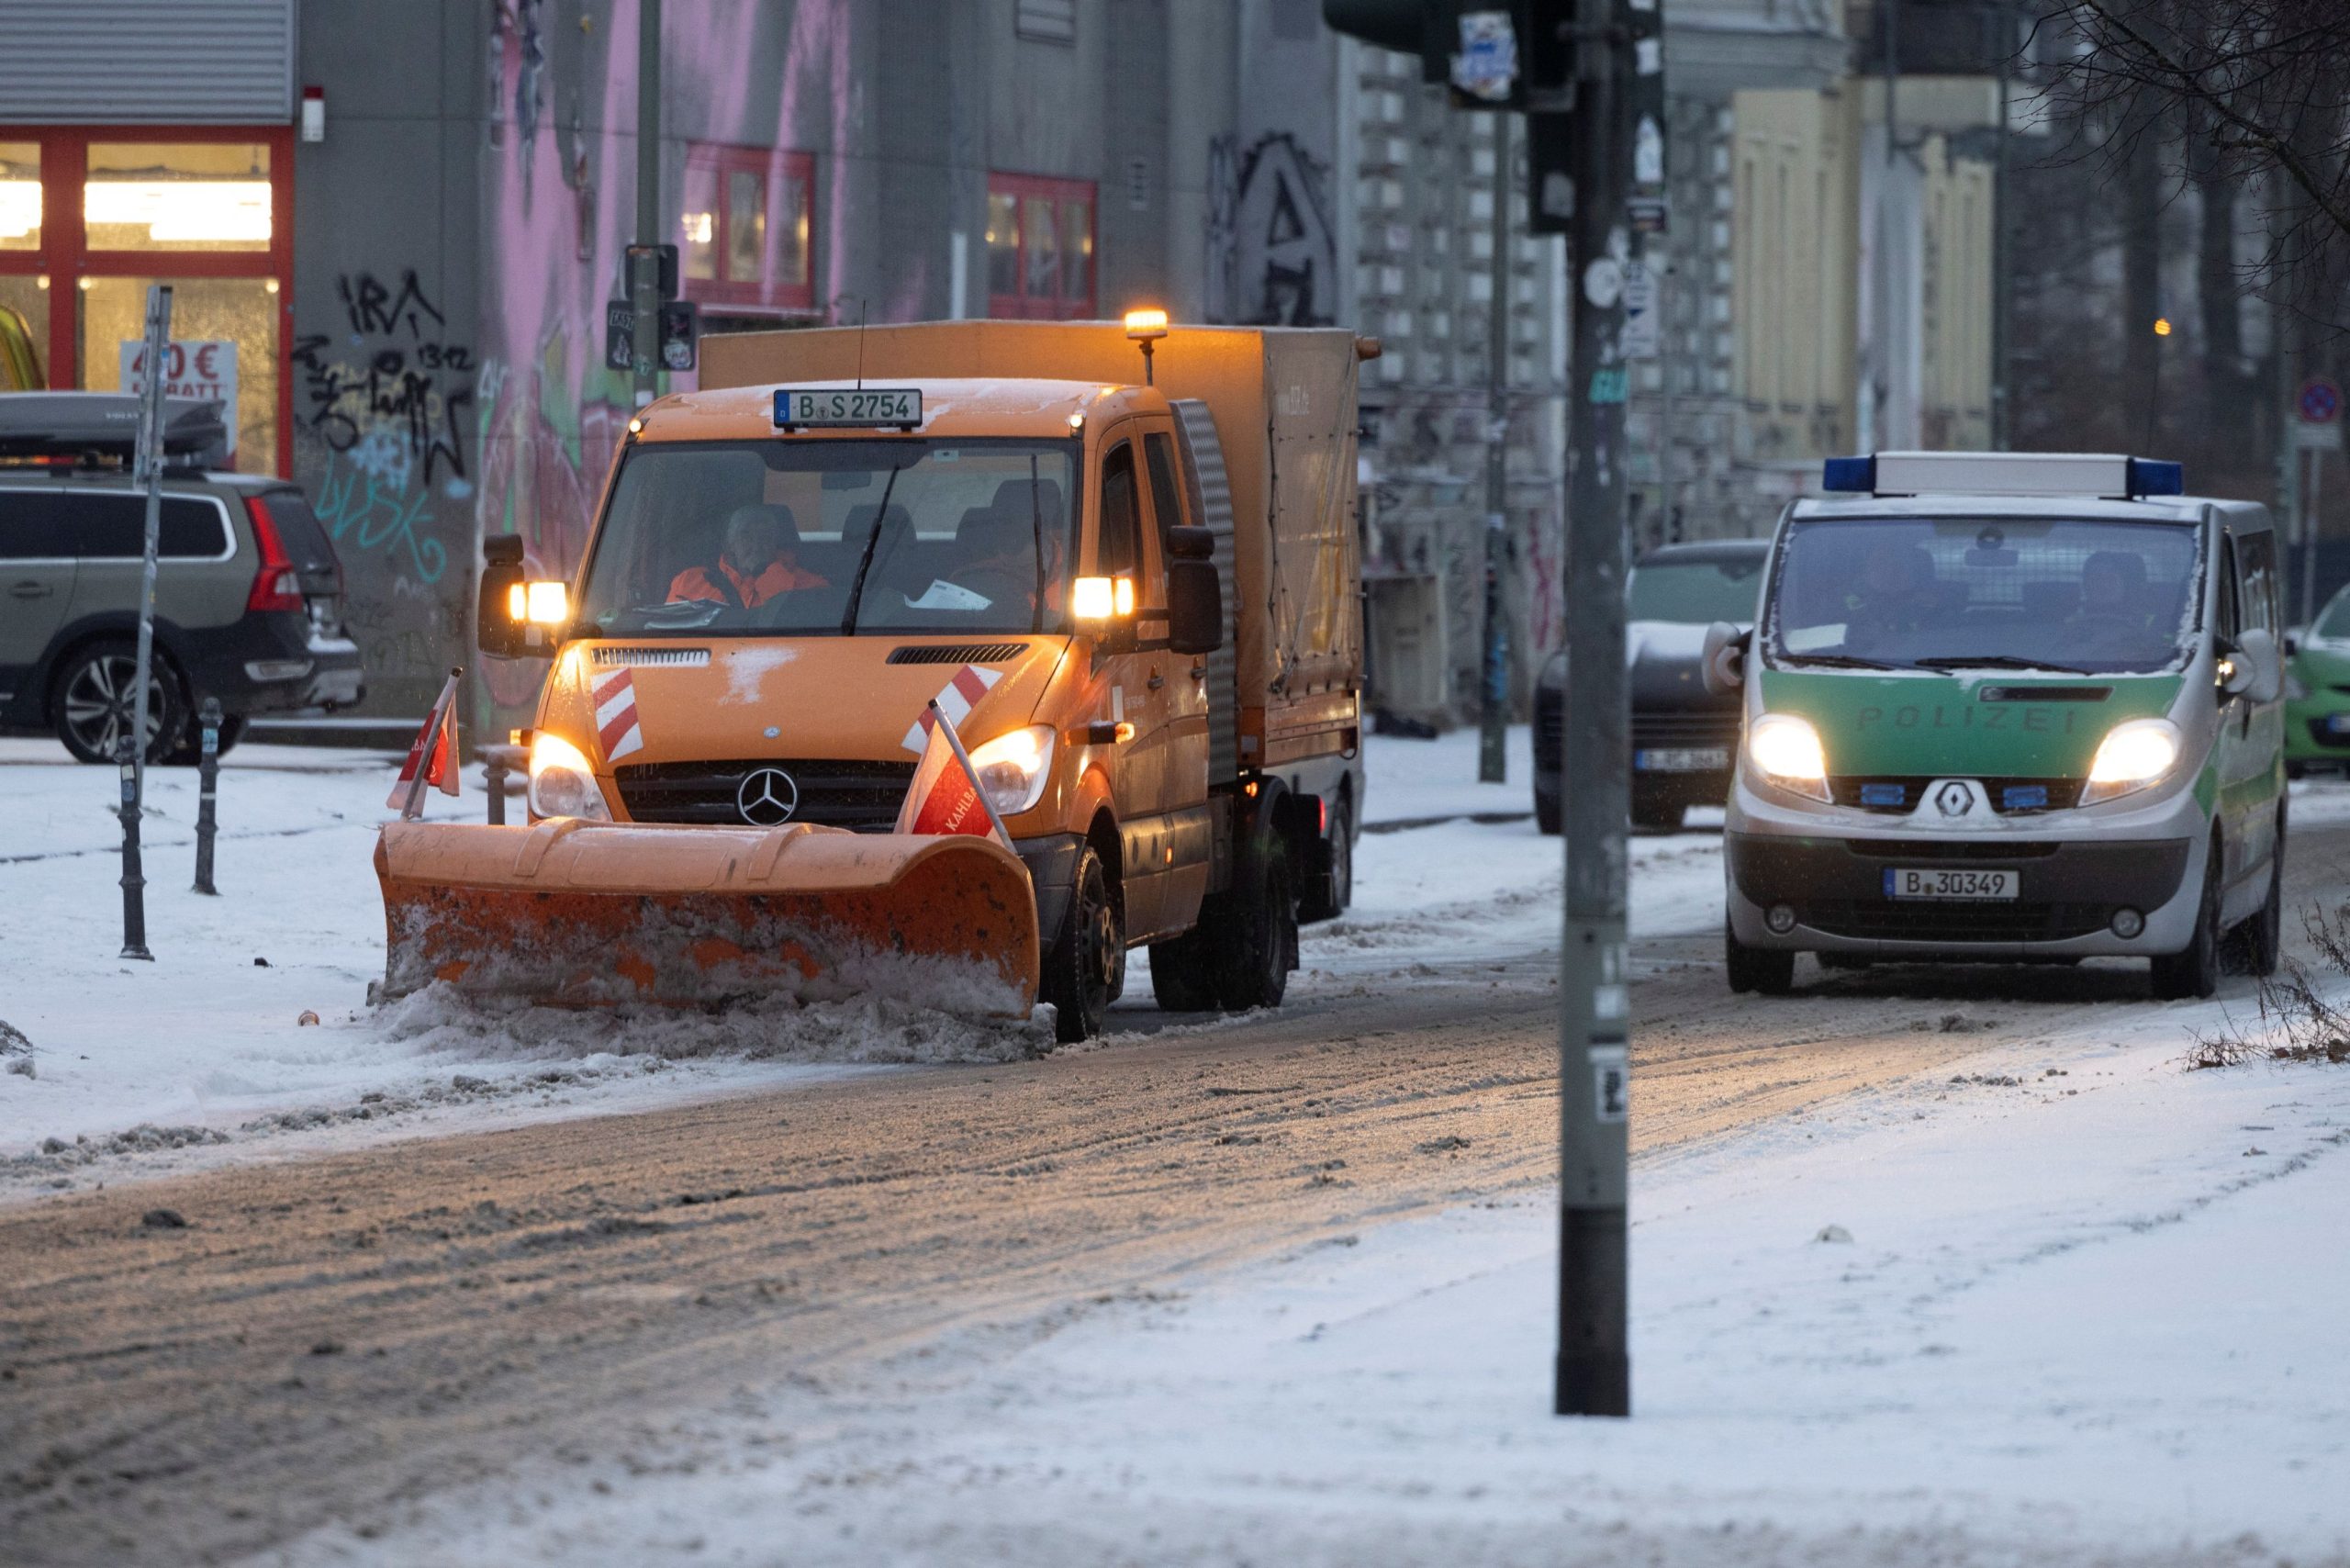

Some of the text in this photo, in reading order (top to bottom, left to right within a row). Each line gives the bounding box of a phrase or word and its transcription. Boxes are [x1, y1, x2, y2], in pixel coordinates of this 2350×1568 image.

[195, 344, 219, 379] €
[132, 383, 223, 399] RBATT
[800, 396, 813, 419] B
[832, 396, 845, 419] S
[852, 395, 909, 419] 2754
[1856, 705, 2076, 735] POLIZEI
[1907, 872, 1920, 893] B
[1936, 873, 2005, 895] 30349
